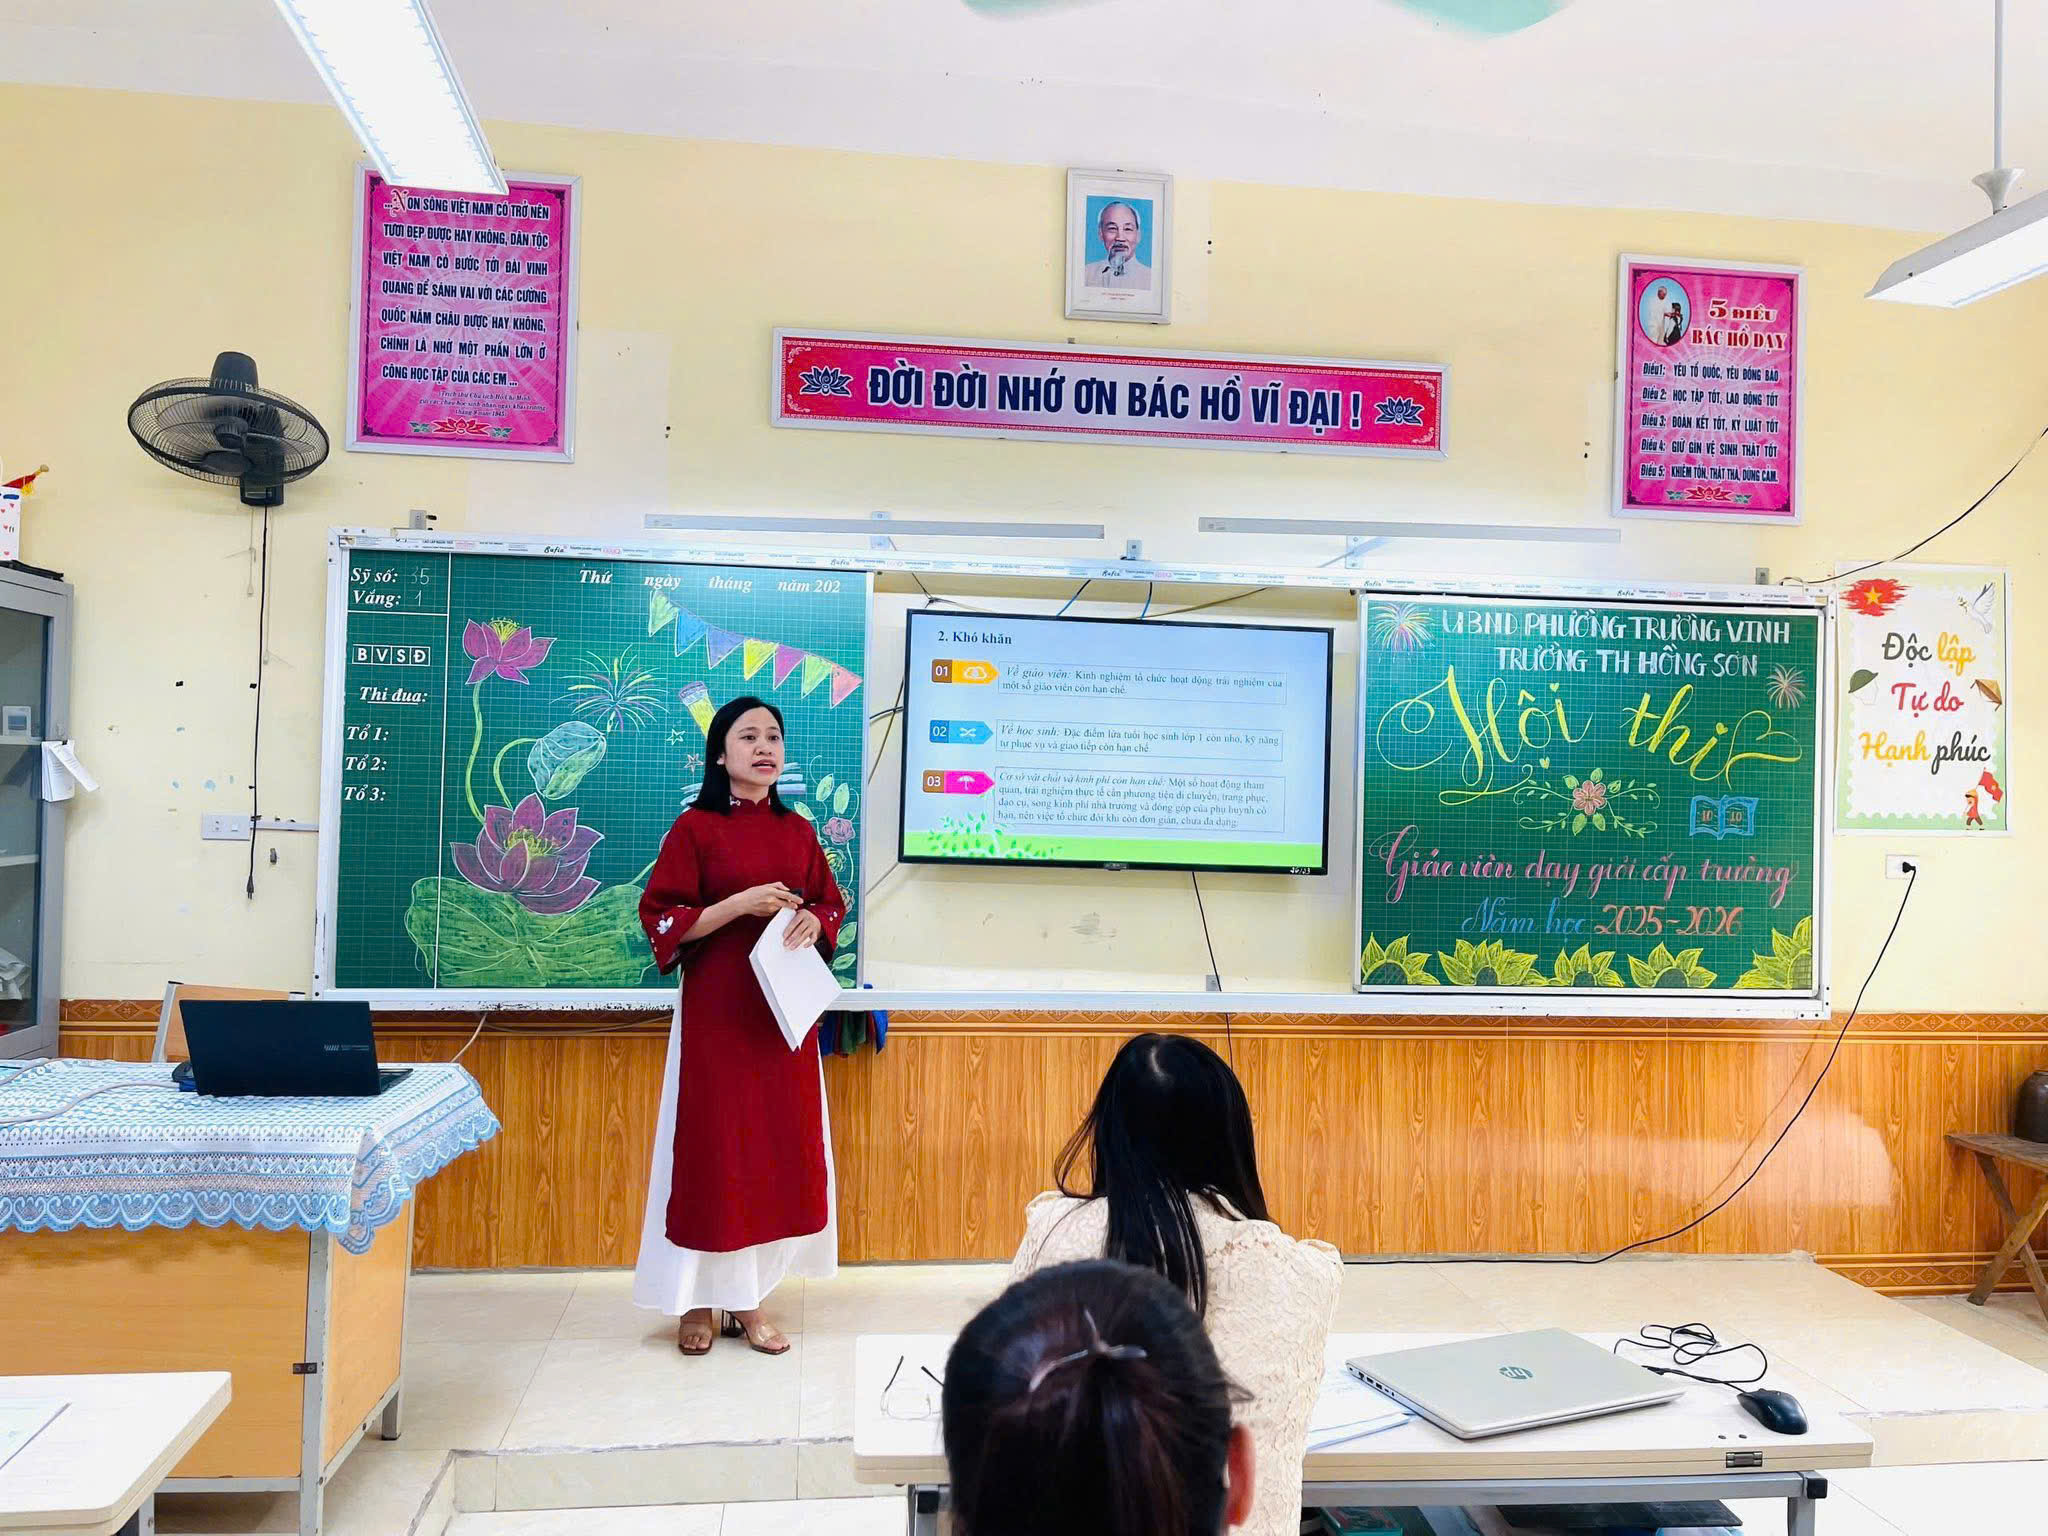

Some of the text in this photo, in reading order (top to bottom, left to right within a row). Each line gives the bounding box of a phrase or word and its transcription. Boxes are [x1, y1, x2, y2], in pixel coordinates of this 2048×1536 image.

[424, 196, 448, 212] SÔNG
[451, 198, 470, 216] VIỆT
[472, 202, 493, 216] NAM
[511, 201, 528, 218] TRỞ
[530, 204, 549, 219] NÊN
[384, 224, 548, 249] TƯƠI ĐẸP ĐƯỢC HAY KHÔNG, DÂN TỘC
[384, 251, 402, 267] VIỆT
[408, 255, 430, 268] NAM
[456, 255, 480, 271] BƯỚC
[527, 262, 548, 275] VINH
[382, 280, 414, 295] QUANG
[417, 279, 429, 296] ĐỂ
[432, 282, 457, 297] SÁNH
[460, 286, 475, 299] VAI
[478, 285, 492, 300] VỚI
[496, 286, 513, 302] CÁC
[382, 305, 546, 332] QUỐC NĂM CHÂU ĐƯỢC HAY KHÔNG,
[1710, 300, 1776, 321] 5 ĐIỀU
[416, 337, 426, 352] LÀ
[459, 340, 478, 358] MỘT
[1692, 325, 1786, 353] BÁC HỒ DẠY
[382, 364, 408, 379] CÔNG
[410, 368, 429, 383] HỌC
[432, 368, 448, 384] TẬP
[452, 366, 469, 383] CỦA
[472, 368, 490, 384] CÁC
[493, 373, 507, 385] EM
[870, 360, 923, 405] ĐỜI
[934, 364, 987, 409] ĐỜI
[998, 368, 1066, 413] NHỚ
[1074, 378, 1117, 415] ƠN
[1128, 376, 1189, 419] BÁC
[1201, 375, 1240, 422] HỒ
[1252, 381, 1281, 423] VĨ
[1289, 390, 1340, 434] ĐẠI
[1673, 390, 1687, 404] HỌC
[1726, 392, 1739, 404] LAO
[1720, 444, 1738, 455] SINH
[351, 568, 372, 585] Sỹ
[375, 568, 399, 583] số:
[580, 570, 841, 594] Thứ ngày tháng năm 202
[354, 588, 402, 609] Vắng:
[1442, 608, 1790, 644] UBND PHƯỜNG TRƯỜNG VINH
[938, 631, 948, 642] 2.
[953, 631, 978, 643] Khó
[1496, 641, 1758, 677] TRƯỜNG TH HỒNG SƠN
[1882, 632, 1976, 676] Độc lập
[936, 666, 948, 677] 01
[360, 686, 428, 702] Thi đua:
[1891, 681, 1964, 718] Tự do
[347, 724, 389, 741] Tổ 1:
[933, 726, 947, 737] 02
[1377, 664, 1803, 805] Hội thi
[346, 754, 387, 771] Tổ 2:
[1858, 731, 1991, 775] Hạnh phúc
[927, 776, 941, 787] 03
[344, 784, 386, 801] Tổ 3:
[1701, 810, 1714, 823] 10
[1729, 811, 1743, 823] 10
[1368, 824, 1454, 904] Giáo
[1460, 853, 1515, 879] viên
[1525, 849, 1580, 899] dạy
[1642, 852, 1688, 901] cấp
[1462, 897, 1744, 943] Năm học 2025-2026
